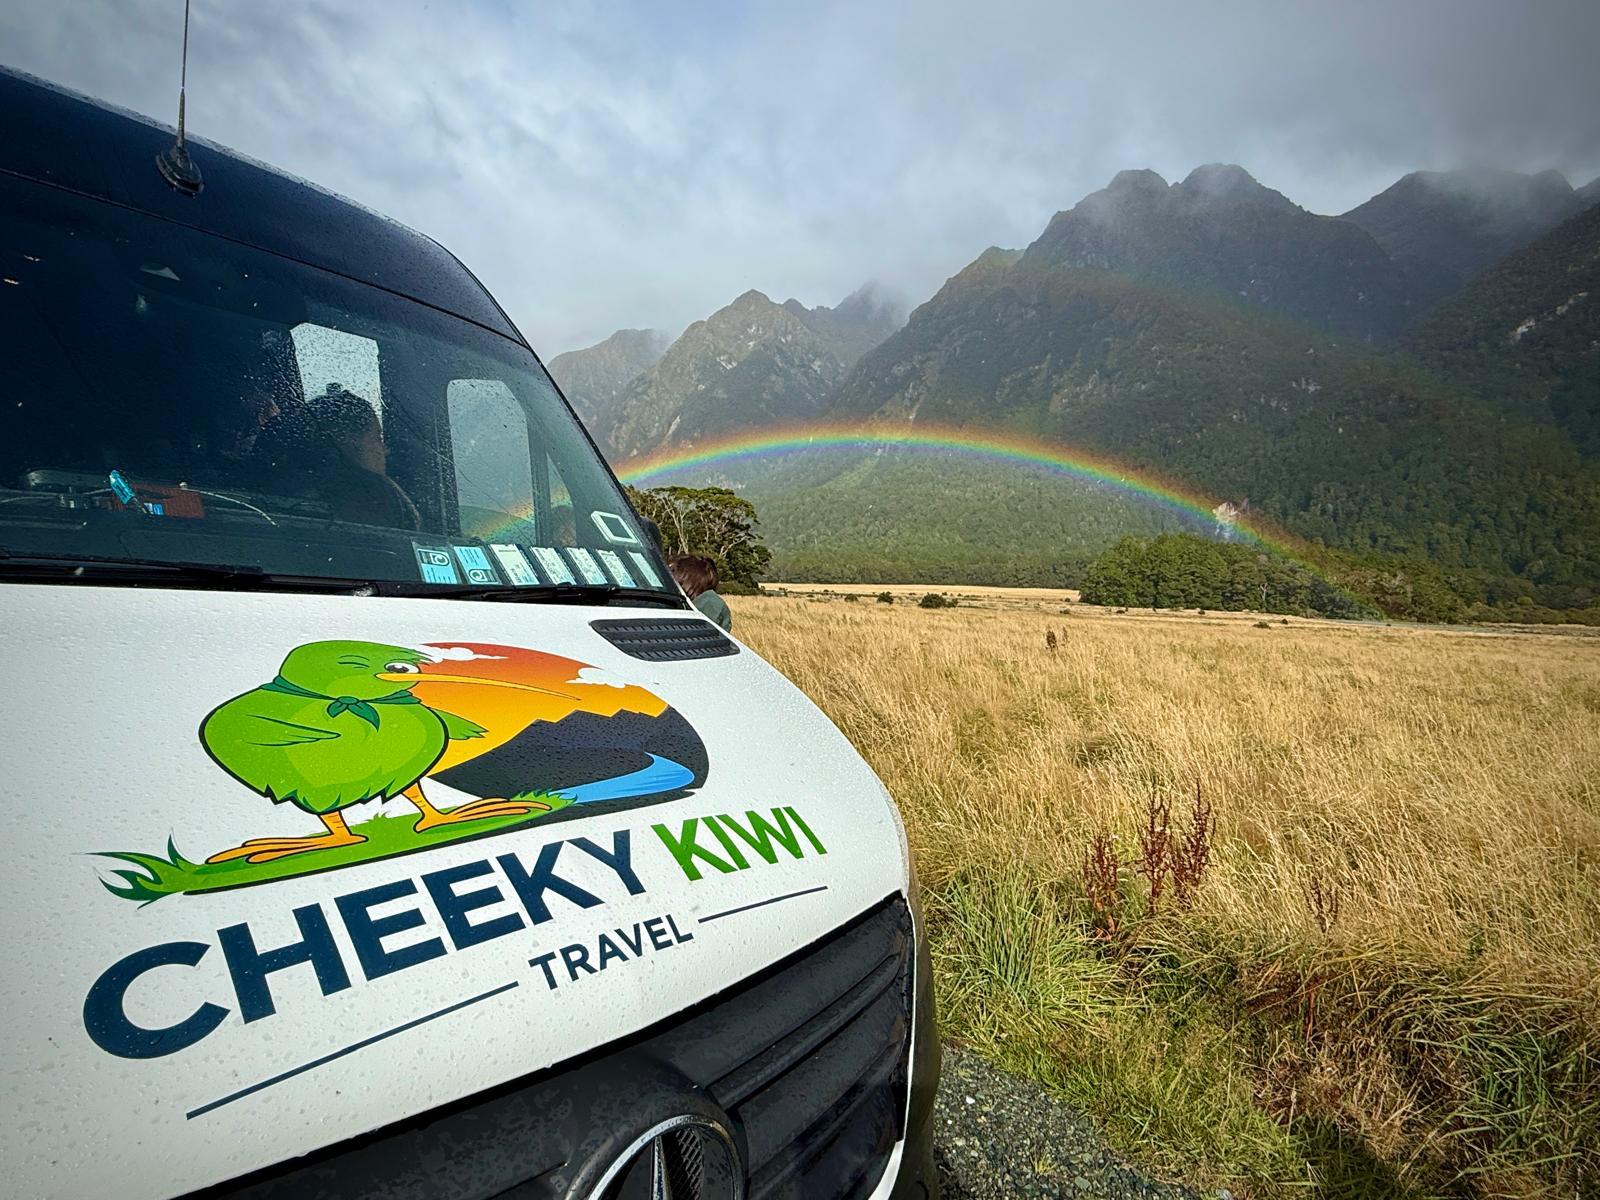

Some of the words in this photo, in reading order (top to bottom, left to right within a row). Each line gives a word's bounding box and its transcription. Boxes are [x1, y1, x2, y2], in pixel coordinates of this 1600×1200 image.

[83, 829, 647, 1059] CHEEKY
[651, 806, 827, 881] KIWI
[529, 914, 694, 990] TRAVEL
